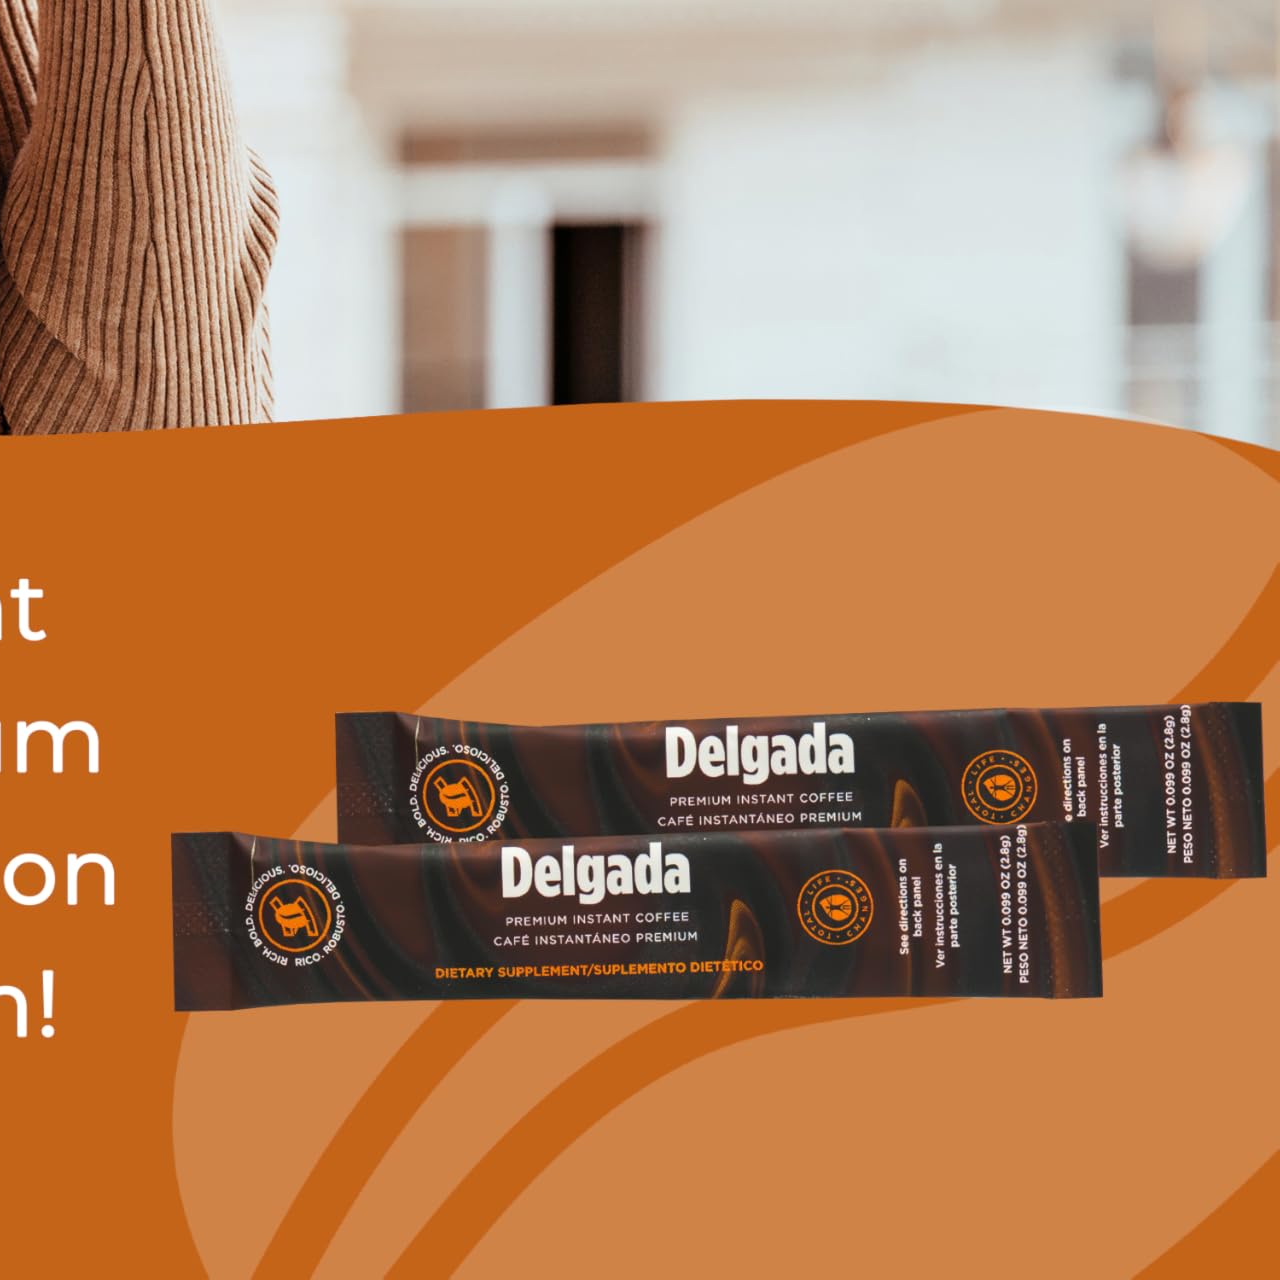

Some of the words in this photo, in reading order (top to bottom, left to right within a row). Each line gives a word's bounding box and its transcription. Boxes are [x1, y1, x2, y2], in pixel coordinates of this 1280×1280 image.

[1097, 724, 1106, 733] la
[1164, 716, 1175, 748] (2.8g)
[1181, 705, 1191, 738] (2.8g)
[666, 722, 854, 784] Delgada
[1063, 739, 1071, 753] on
[1099, 737, 1106, 750] en
[1181, 742, 1190, 758] OZ
[1076, 757, 1087, 787] panel
[1111, 744, 1123, 795] posterior
[1165, 753, 1174, 769] OZ
[1062, 756, 1072, 811] directions
[1098, 754, 1108, 826] instrucciones
[1165, 772, 1175, 806] 0.099
[1182, 762, 1191, 795] 0.099
[671, 796, 730, 806] PREMIUM
[737, 794, 793, 804] INSTANT
[800, 792, 852, 803] COFFEE
[1076, 790, 1086, 817] back
[1113, 798, 1124, 827] parte
[658, 815, 693, 826] CAFÉ
[700, 813, 794, 825] INSTANTÁNEO
[801, 812, 861, 822] PREMIUM
[1167, 811, 1176, 827] WT
[1183, 800, 1192, 830] NETO
[933, 843, 942, 853] la
[1000, 836, 1011, 869] (2.8g)
[1016, 825, 1027, 858] (2.8g)
[1100, 829, 1109, 848] Ver
[1167, 834, 1176, 853] NET
[1183, 834, 1192, 863] PESO
[502, 842, 690, 904] Delgada
[899, 859, 906, 873] on
[935, 857, 942, 870] en
[1017, 861, 1026, 879] OZ
[912, 877, 922, 907] panel
[948, 864, 959, 915] posterior
[1001, 872, 1010, 889] OZ
[898, 876, 908, 931] directions
[934, 873, 944, 947] instrucciones
[1001, 893, 1011, 926] 0.099
[1018, 884, 1027, 915] 0.099
[506, 916, 566, 926] PREMIUM
[574, 914, 630, 924] INSTANT
[636, 912, 688, 922] COFFEE
[912, 910, 922, 937] back
[949, 918, 960, 948] parte
[494, 935, 529, 946] CAFÉ
[536, 933, 630, 944] INSTANTÁNEO
[637, 932, 697, 942] PREMIUM
[900, 934, 909, 955] See
[1003, 929, 1011, 948] WT
[1019, 919, 1028, 950] NETO
[435, 966, 494, 979] DIETARY
[497, 962, 685, 978] SUPPLEMENT/SUPLEMENTO
[936, 949, 944, 968] Ver
[1003, 951, 1012, 973] NET
[1019, 952, 1028, 983] PESO
